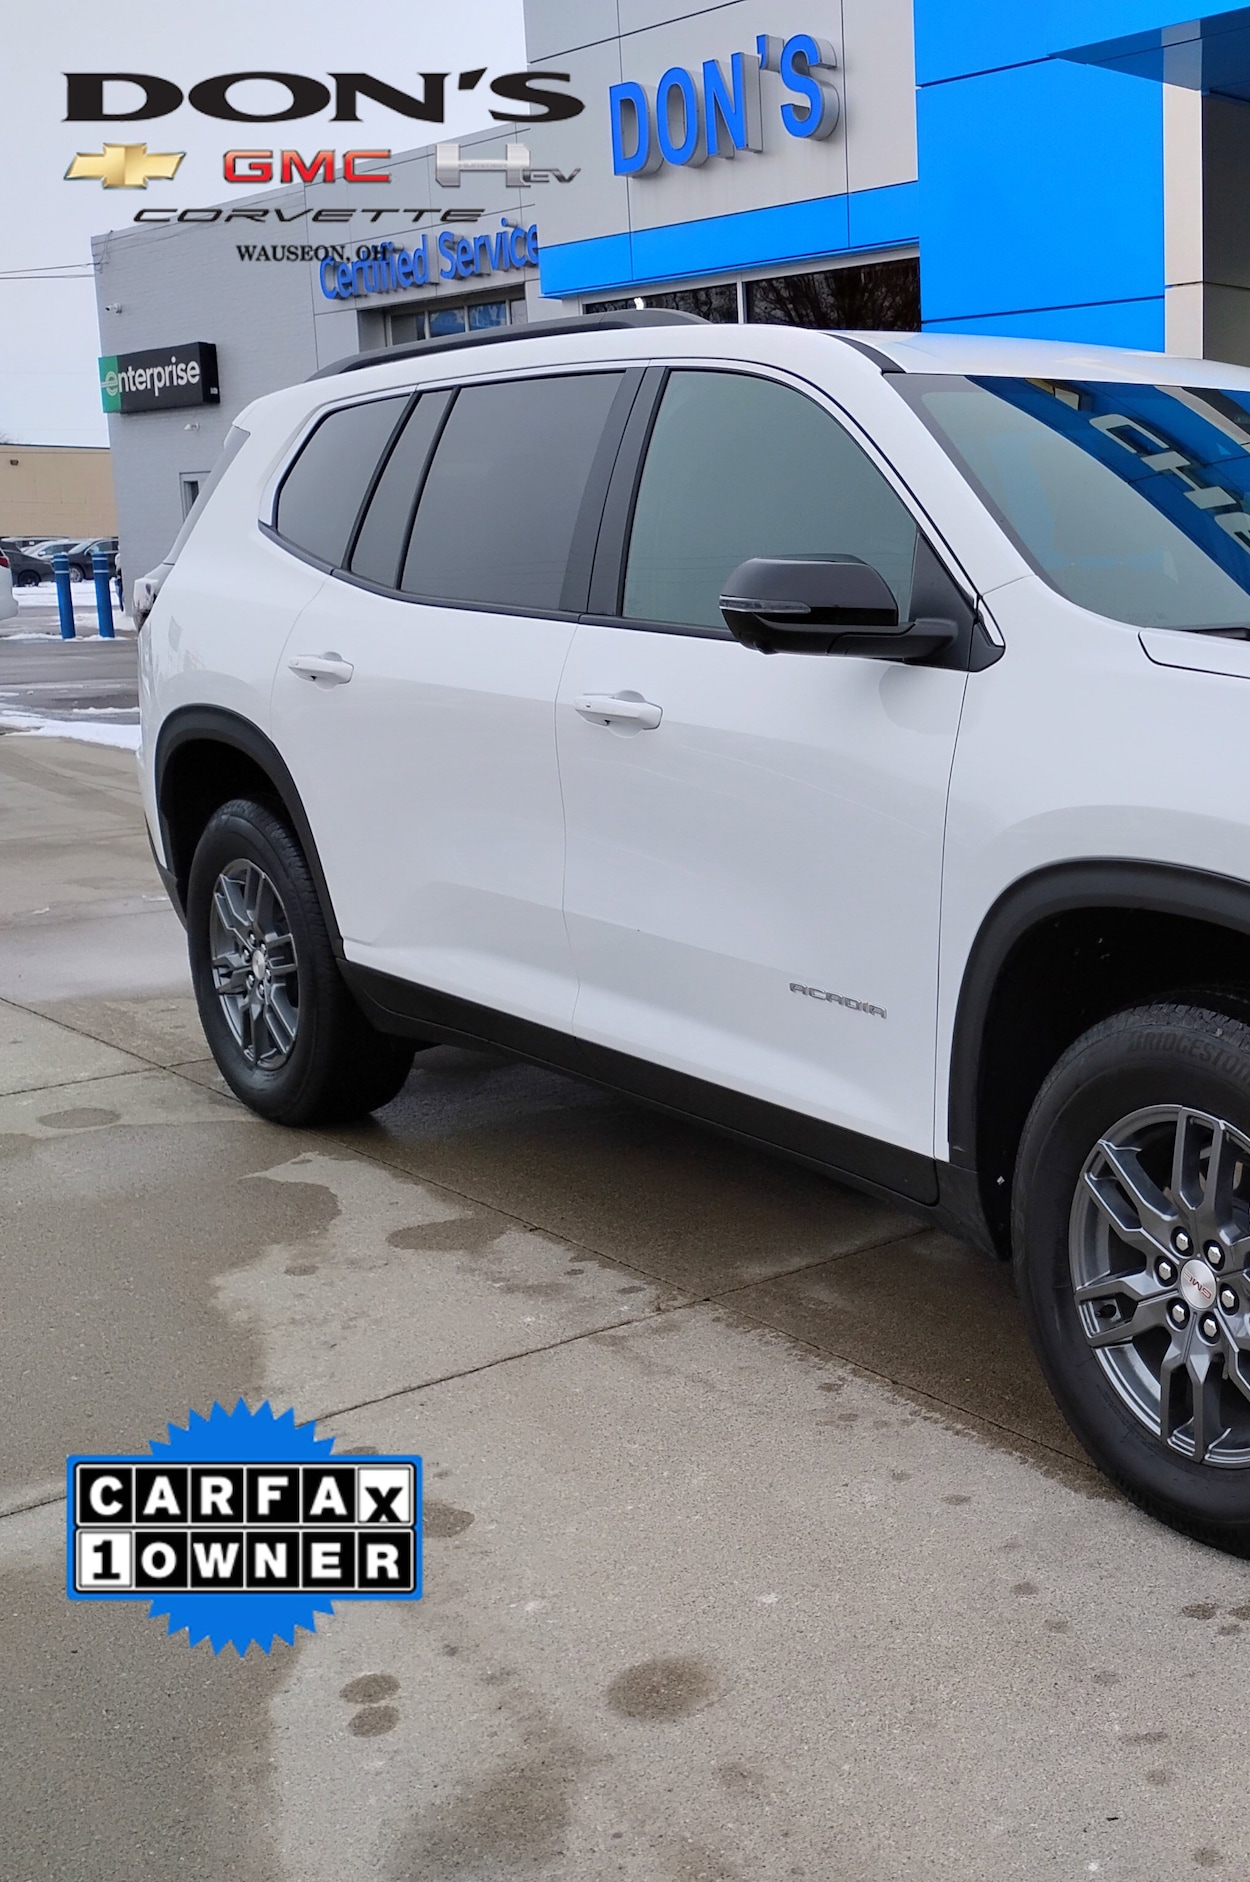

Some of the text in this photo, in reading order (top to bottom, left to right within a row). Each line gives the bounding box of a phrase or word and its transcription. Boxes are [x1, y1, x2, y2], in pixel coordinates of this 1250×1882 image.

[608, 34, 830, 176] DON'S
[319, 217, 539, 300] Certified Service
[103, 355, 200, 397] enterprise
[789, 982, 888, 1019] ACADIA
[1183, 1268, 1212, 1299] GMC
